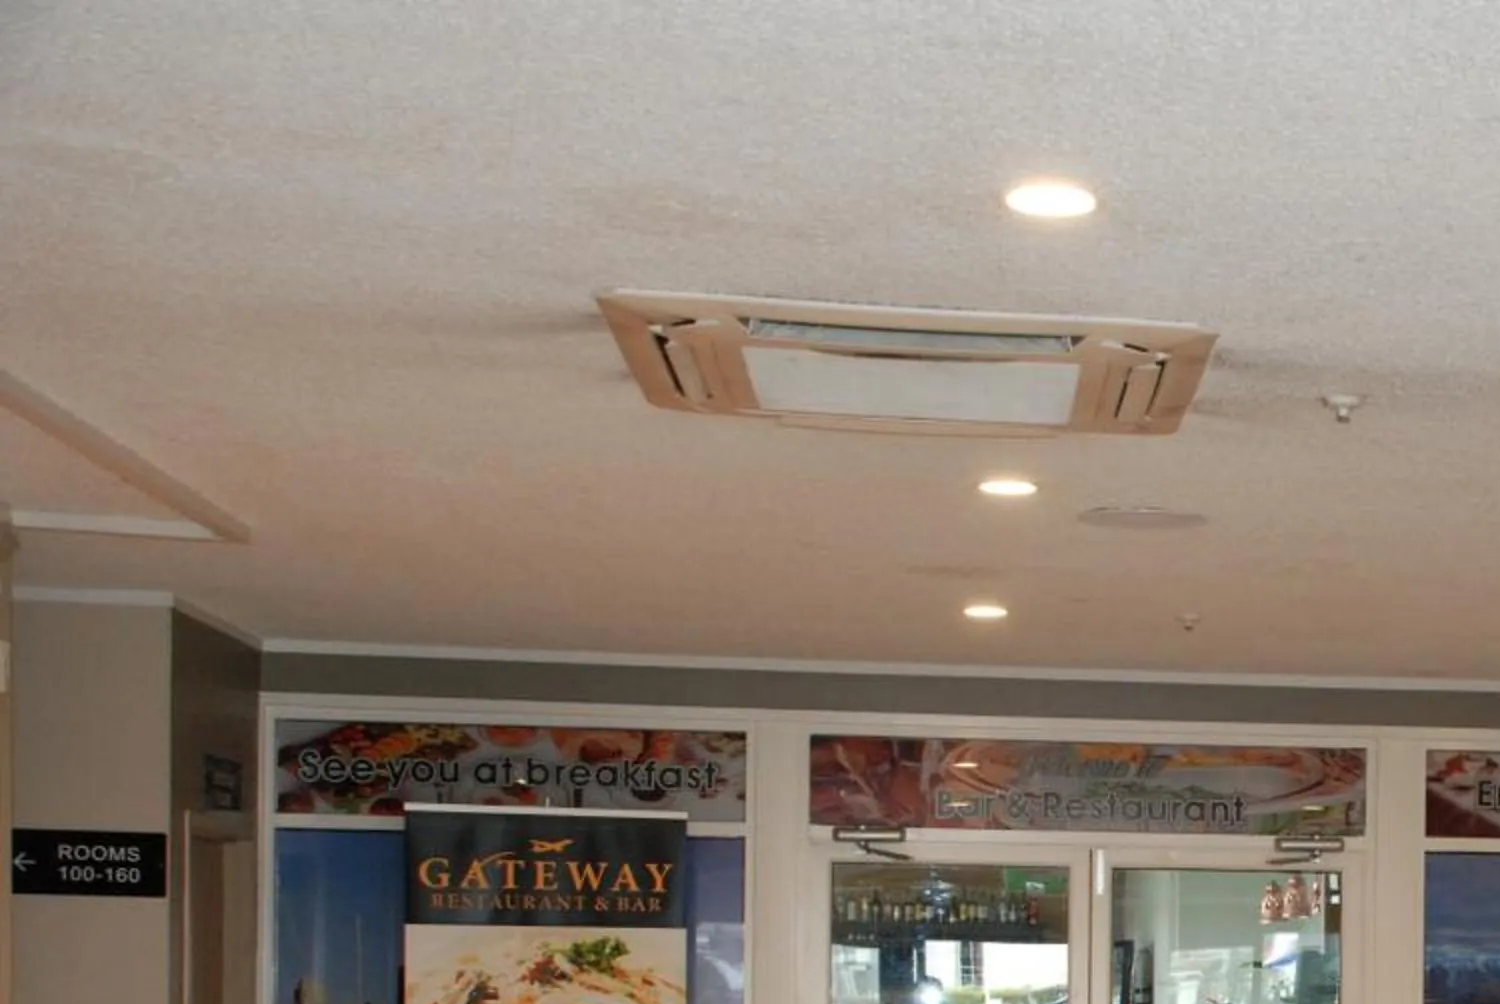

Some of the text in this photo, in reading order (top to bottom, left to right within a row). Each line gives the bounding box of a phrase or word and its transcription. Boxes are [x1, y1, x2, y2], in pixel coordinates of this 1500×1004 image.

[301, 750, 719, 791] See you at breakfast
[936, 789, 1246, 824] Bar & Restaurant
[57, 844, 141, 862] ROOMS
[58, 865, 141, 883] 100-160
[418, 853, 673, 893] GATEWAY
[430, 894, 662, 912] RESTAURANT & BAR
